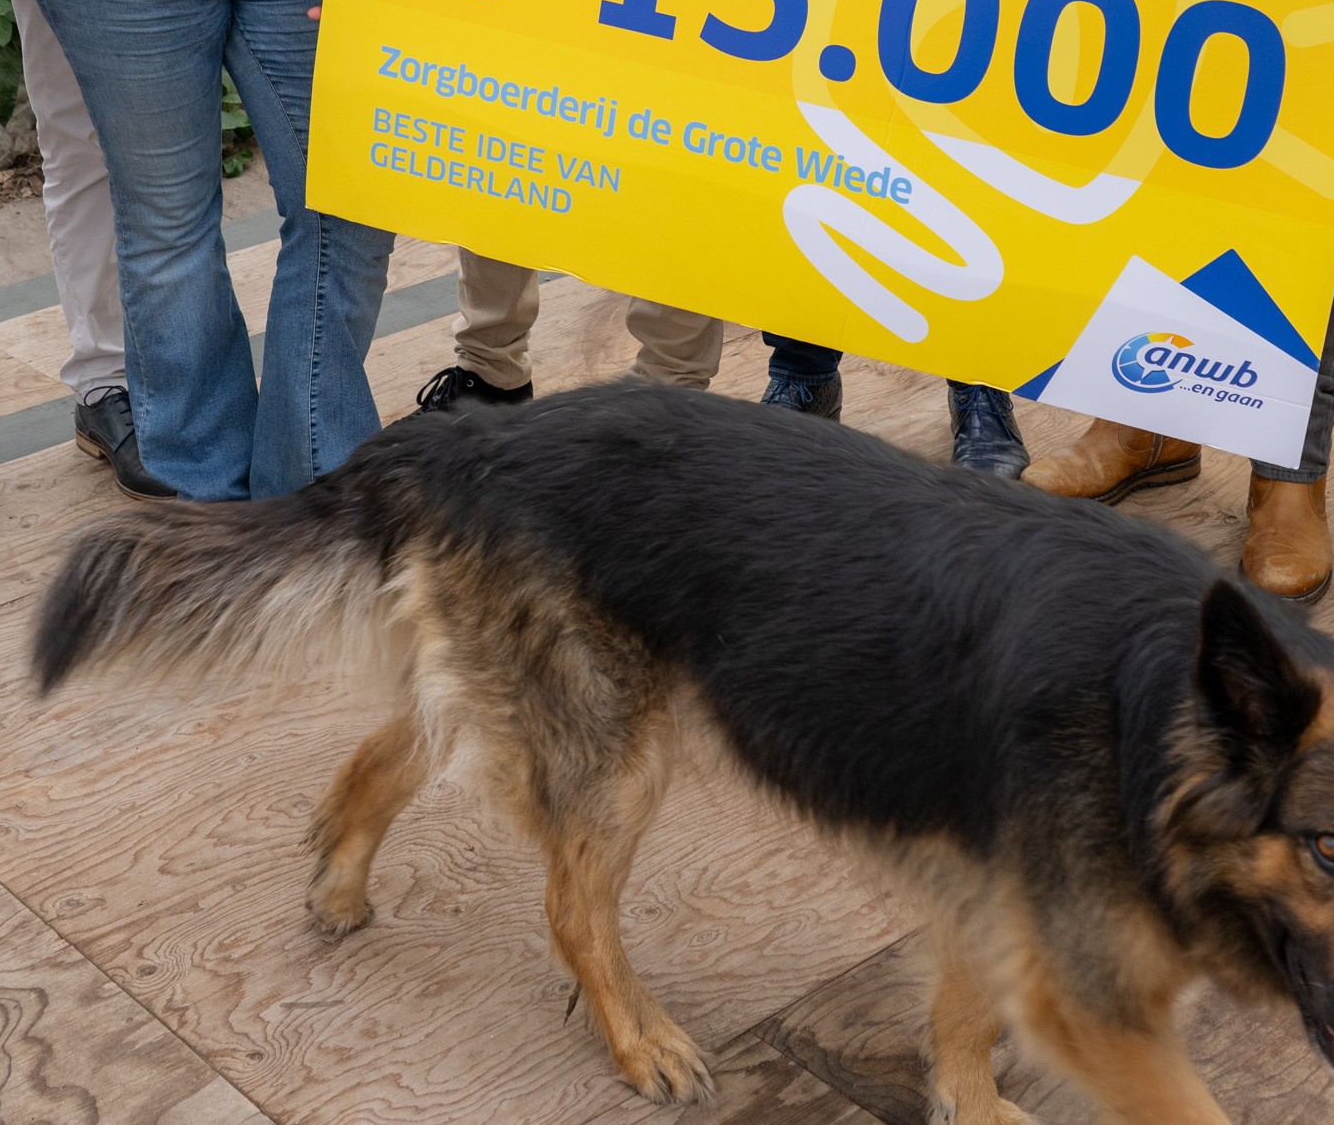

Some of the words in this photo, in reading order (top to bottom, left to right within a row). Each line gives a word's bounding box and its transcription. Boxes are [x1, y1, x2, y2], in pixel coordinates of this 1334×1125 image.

[373, 108, 465, 152] BESTE
[476, 134, 545, 173] IDEE
[557, 154, 620, 191] VAN
[379, 46, 616, 136] Zorgboerderij
[628, 109, 671, 144] de
[683, 122, 782, 170] Grote
[797, 148, 913, 203] Wiede
[370, 143, 571, 213] GELDERLAND
[1144, 346, 1258, 388] anwb
